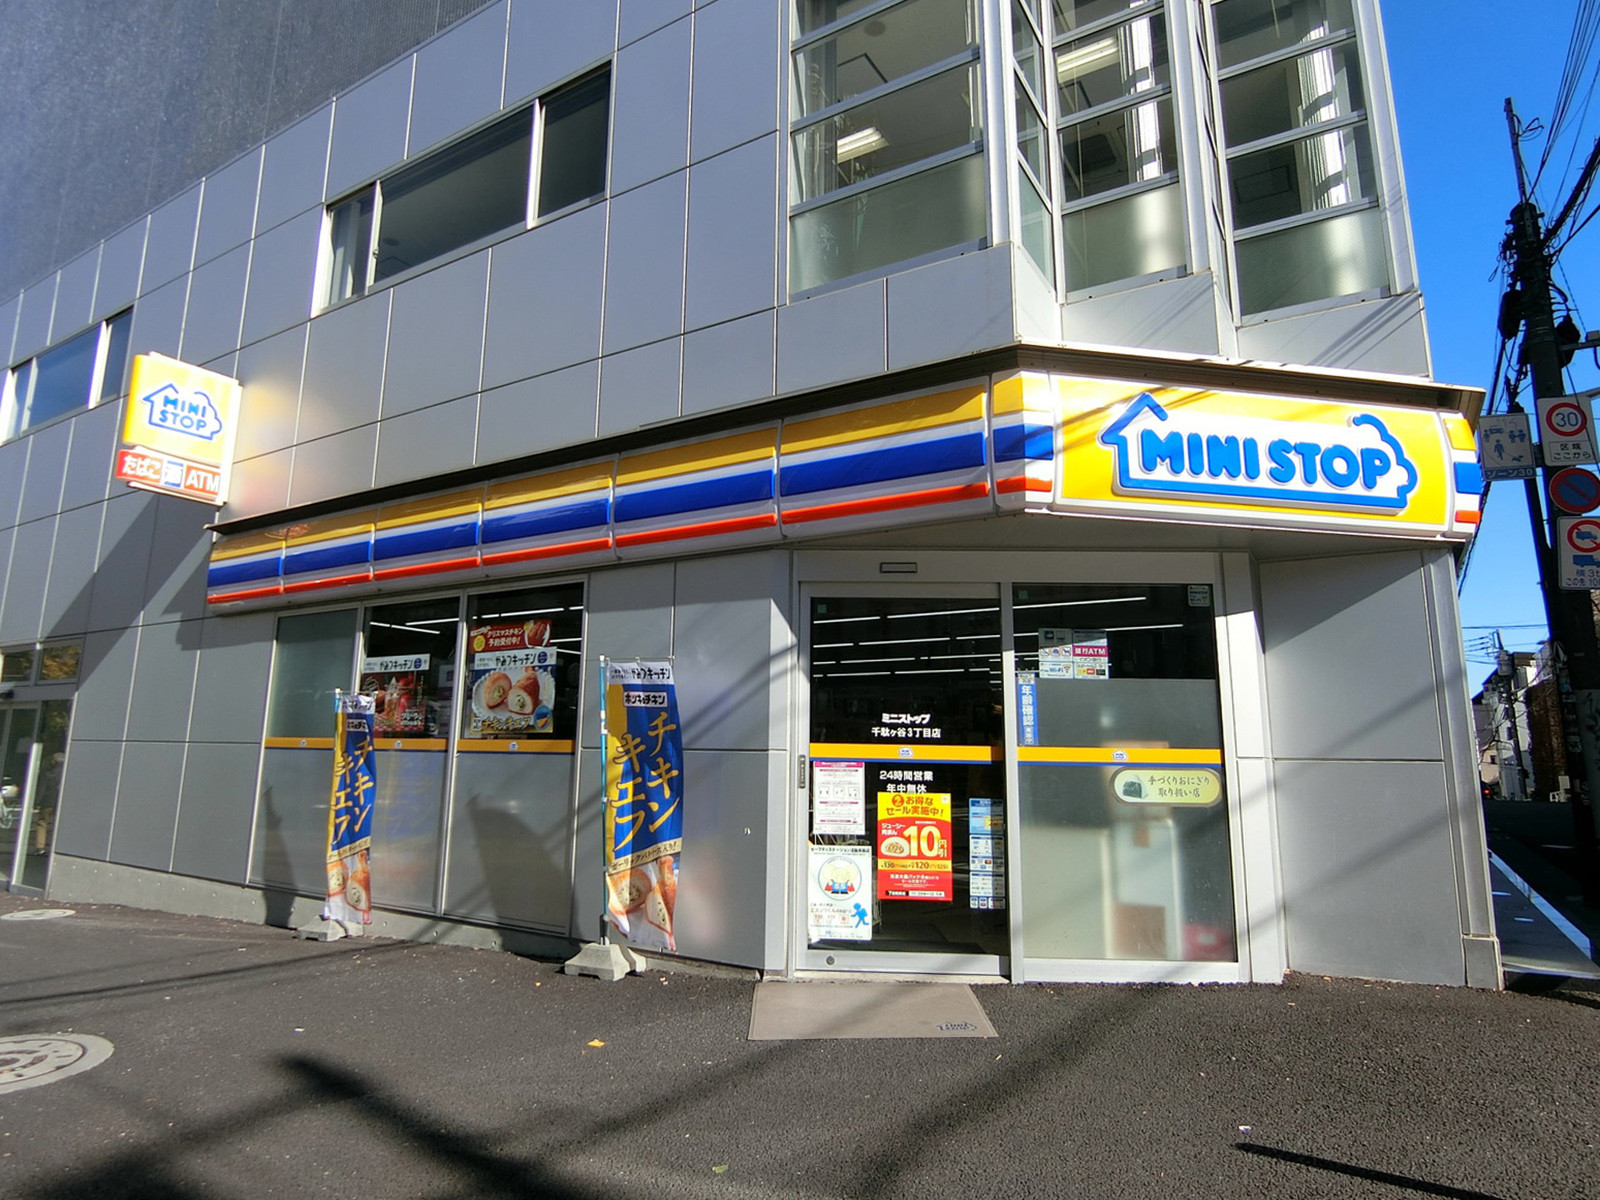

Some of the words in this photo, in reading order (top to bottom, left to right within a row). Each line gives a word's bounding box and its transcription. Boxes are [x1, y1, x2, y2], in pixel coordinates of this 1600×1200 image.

[163, 395, 207, 418] MINI
[158, 410, 207, 431] STOP
[1555, 412, 1579, 428] 30
[1560, 442, 1582, 451] 区域
[1139, 427, 1260, 480] MINI
[1267, 438, 1392, 490] STOP
[1553, 450, 1592, 460] ここから
[121, 455, 161, 479] たばこ
[185, 469, 220, 493] ATM
[881, 712, 931, 724] ミニストップ
[871, 726, 942, 738] 千駄ヶ谷3丁目店
[647, 711, 680, 833] チキン
[879, 769, 934, 782] 24時間営業
[1147, 774, 1210, 786] 手づくりおにぎり
[610, 733, 647, 852] キエフ
[886, 782, 928, 794] 年中無休
[1158, 787, 1201, 798] 取り扱い店
[886, 805, 944, 818] セール実施中!
[903, 825, 942, 858] 10
